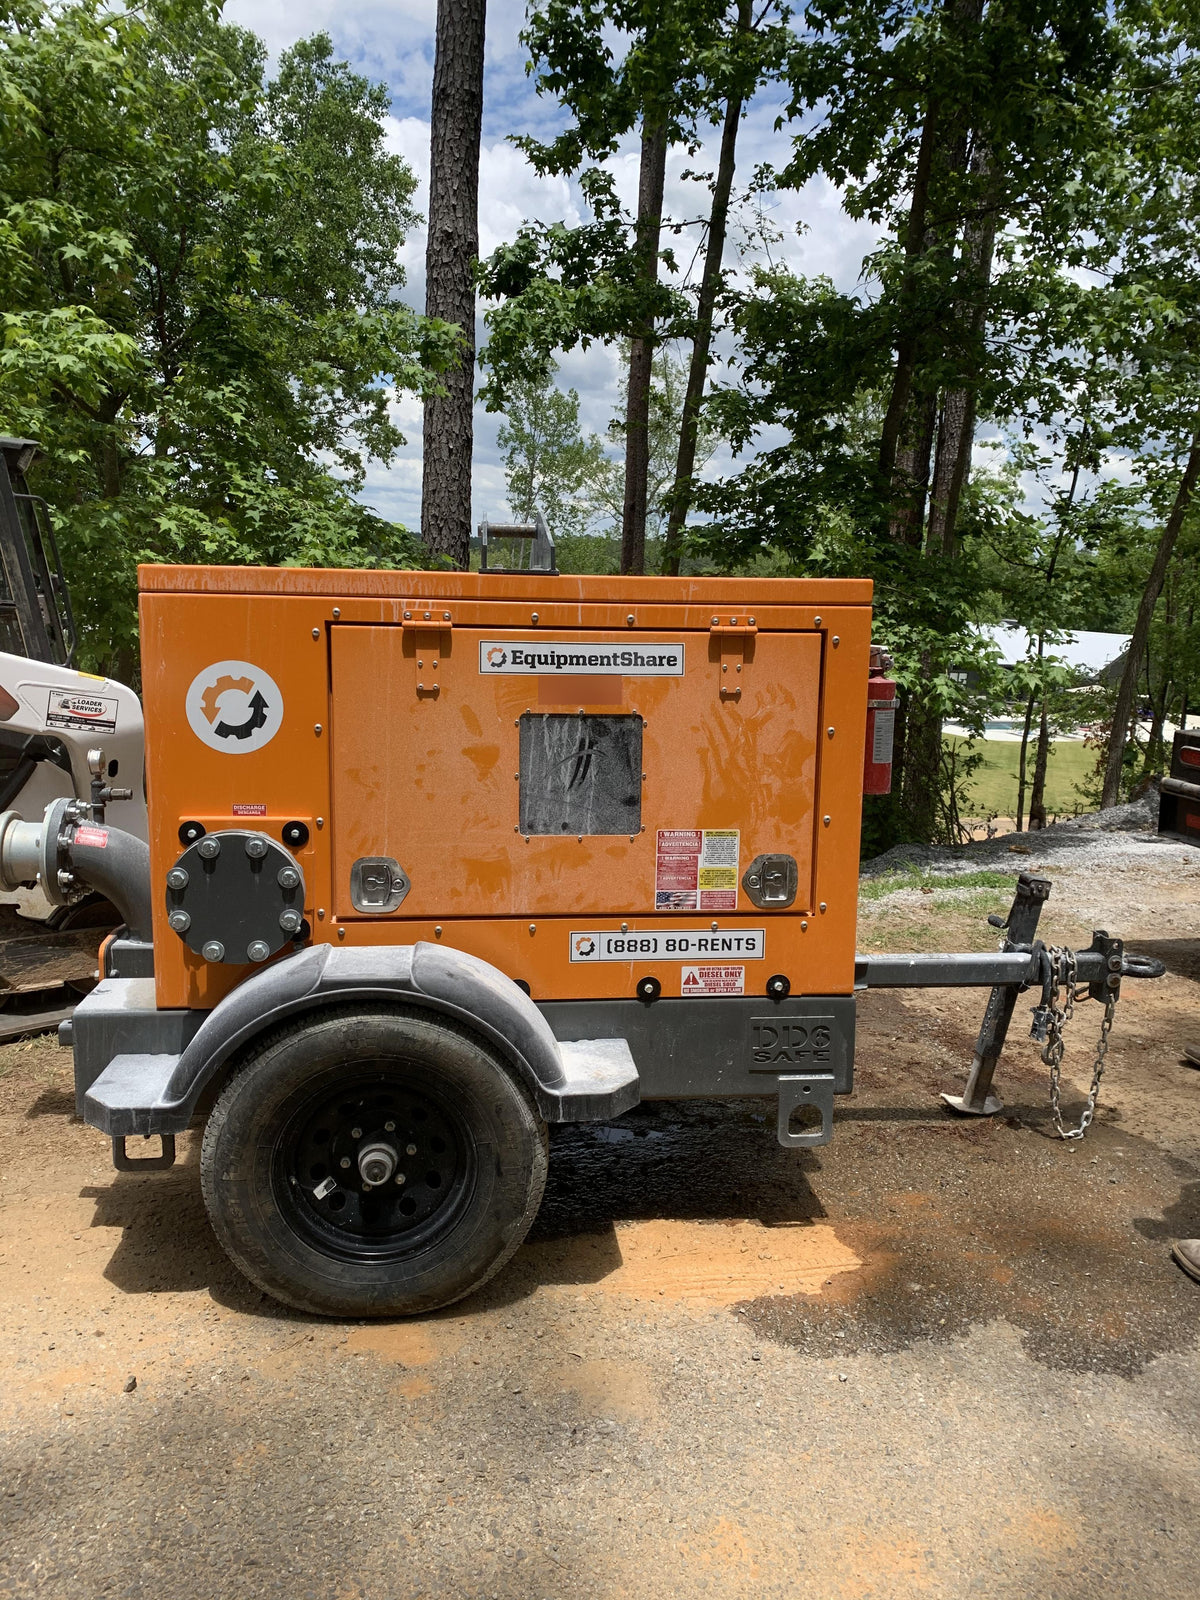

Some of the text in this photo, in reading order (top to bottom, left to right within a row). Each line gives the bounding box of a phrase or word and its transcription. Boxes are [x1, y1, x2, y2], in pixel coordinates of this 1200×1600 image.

[511, 649, 678, 669] EquipmentShare
[71, 704, 103, 713] SERVICES
[77, 699, 103, 707] LOADER
[606, 937, 757, 953] (888) 80-RENTS
[724, 970, 742, 978] ONLY
[752, 1050, 830, 1064] SAFE
